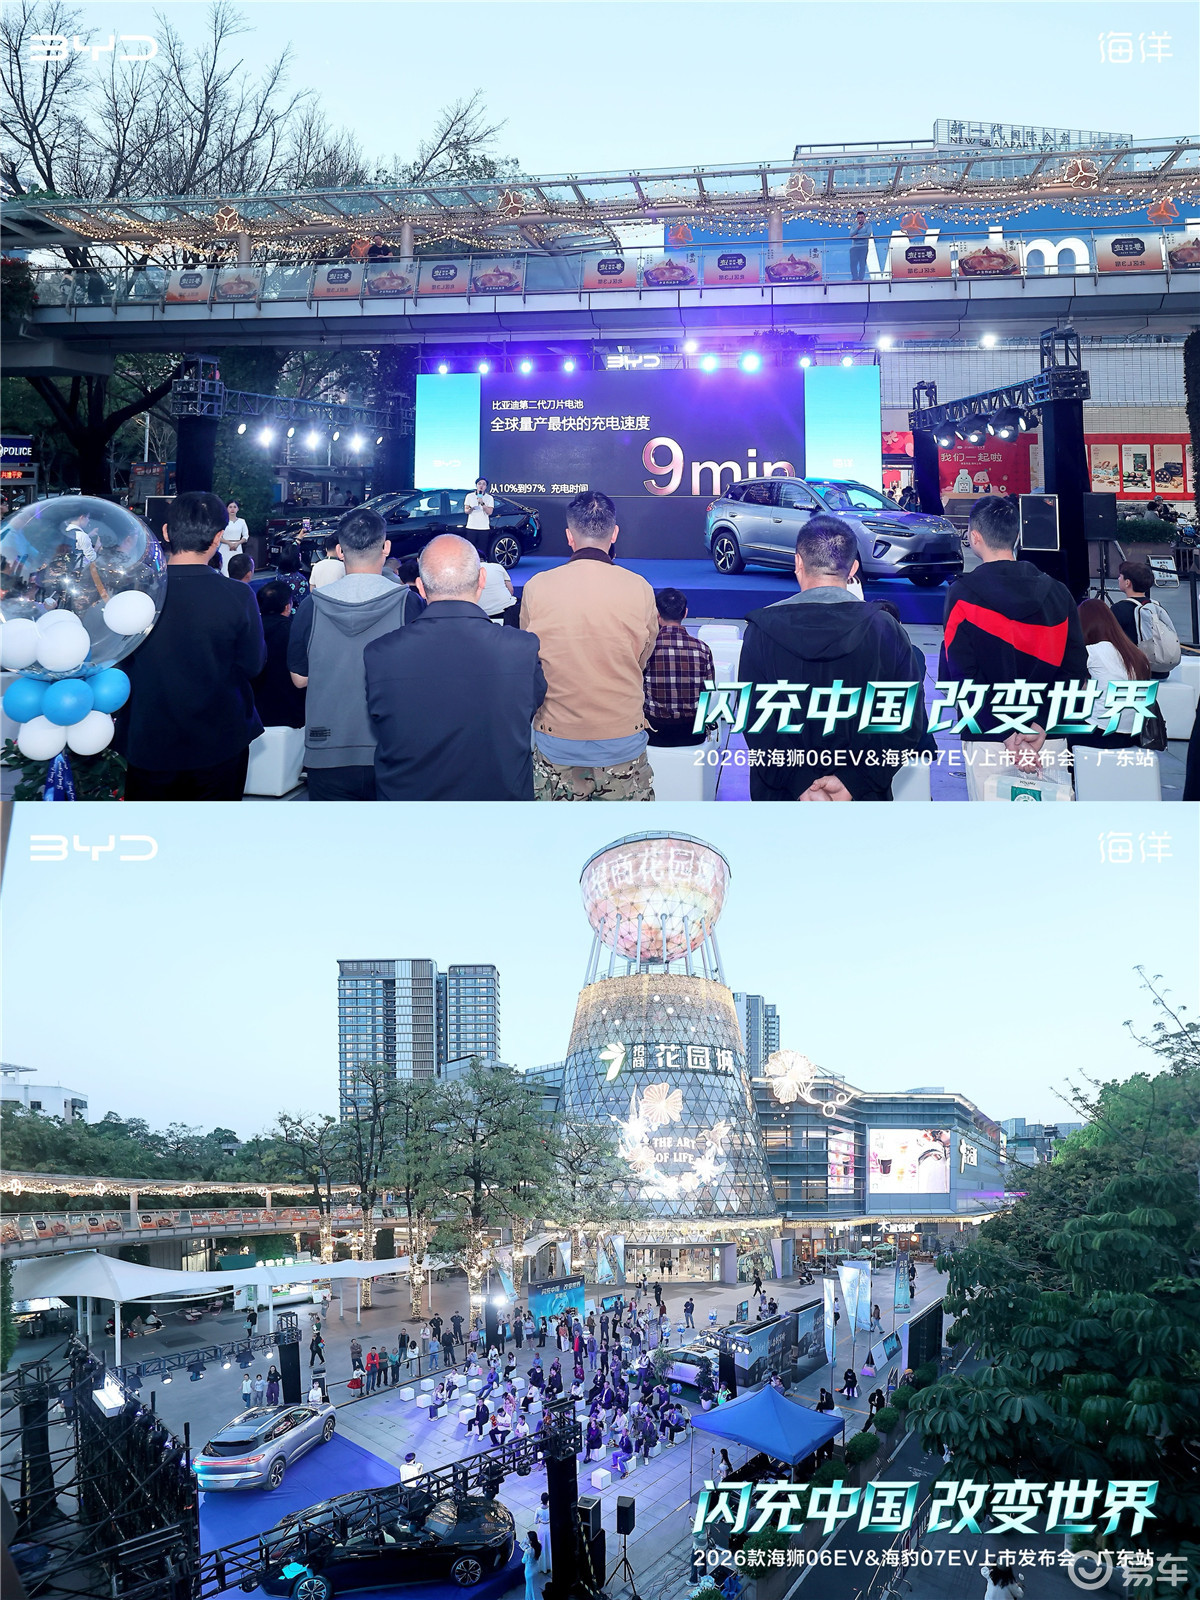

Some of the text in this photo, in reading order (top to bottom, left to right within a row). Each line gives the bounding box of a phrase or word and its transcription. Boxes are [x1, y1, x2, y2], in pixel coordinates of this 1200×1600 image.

[950, 136, 976, 145] NEW
[607, 355, 661, 368] BYD
[492, 399, 584, 410] 比亚迪第二代刀片电池
[490, 415, 650, 432] 全球量产最快的充电速度
[3, 447, 32, 455] POLICE
[940, 452, 1003, 463] 我们一起啦
[655, 1044, 734, 1073] 花园城
[652, 1137, 696, 1150] THE ART
[655, 1151, 696, 1164] OF LIFE
